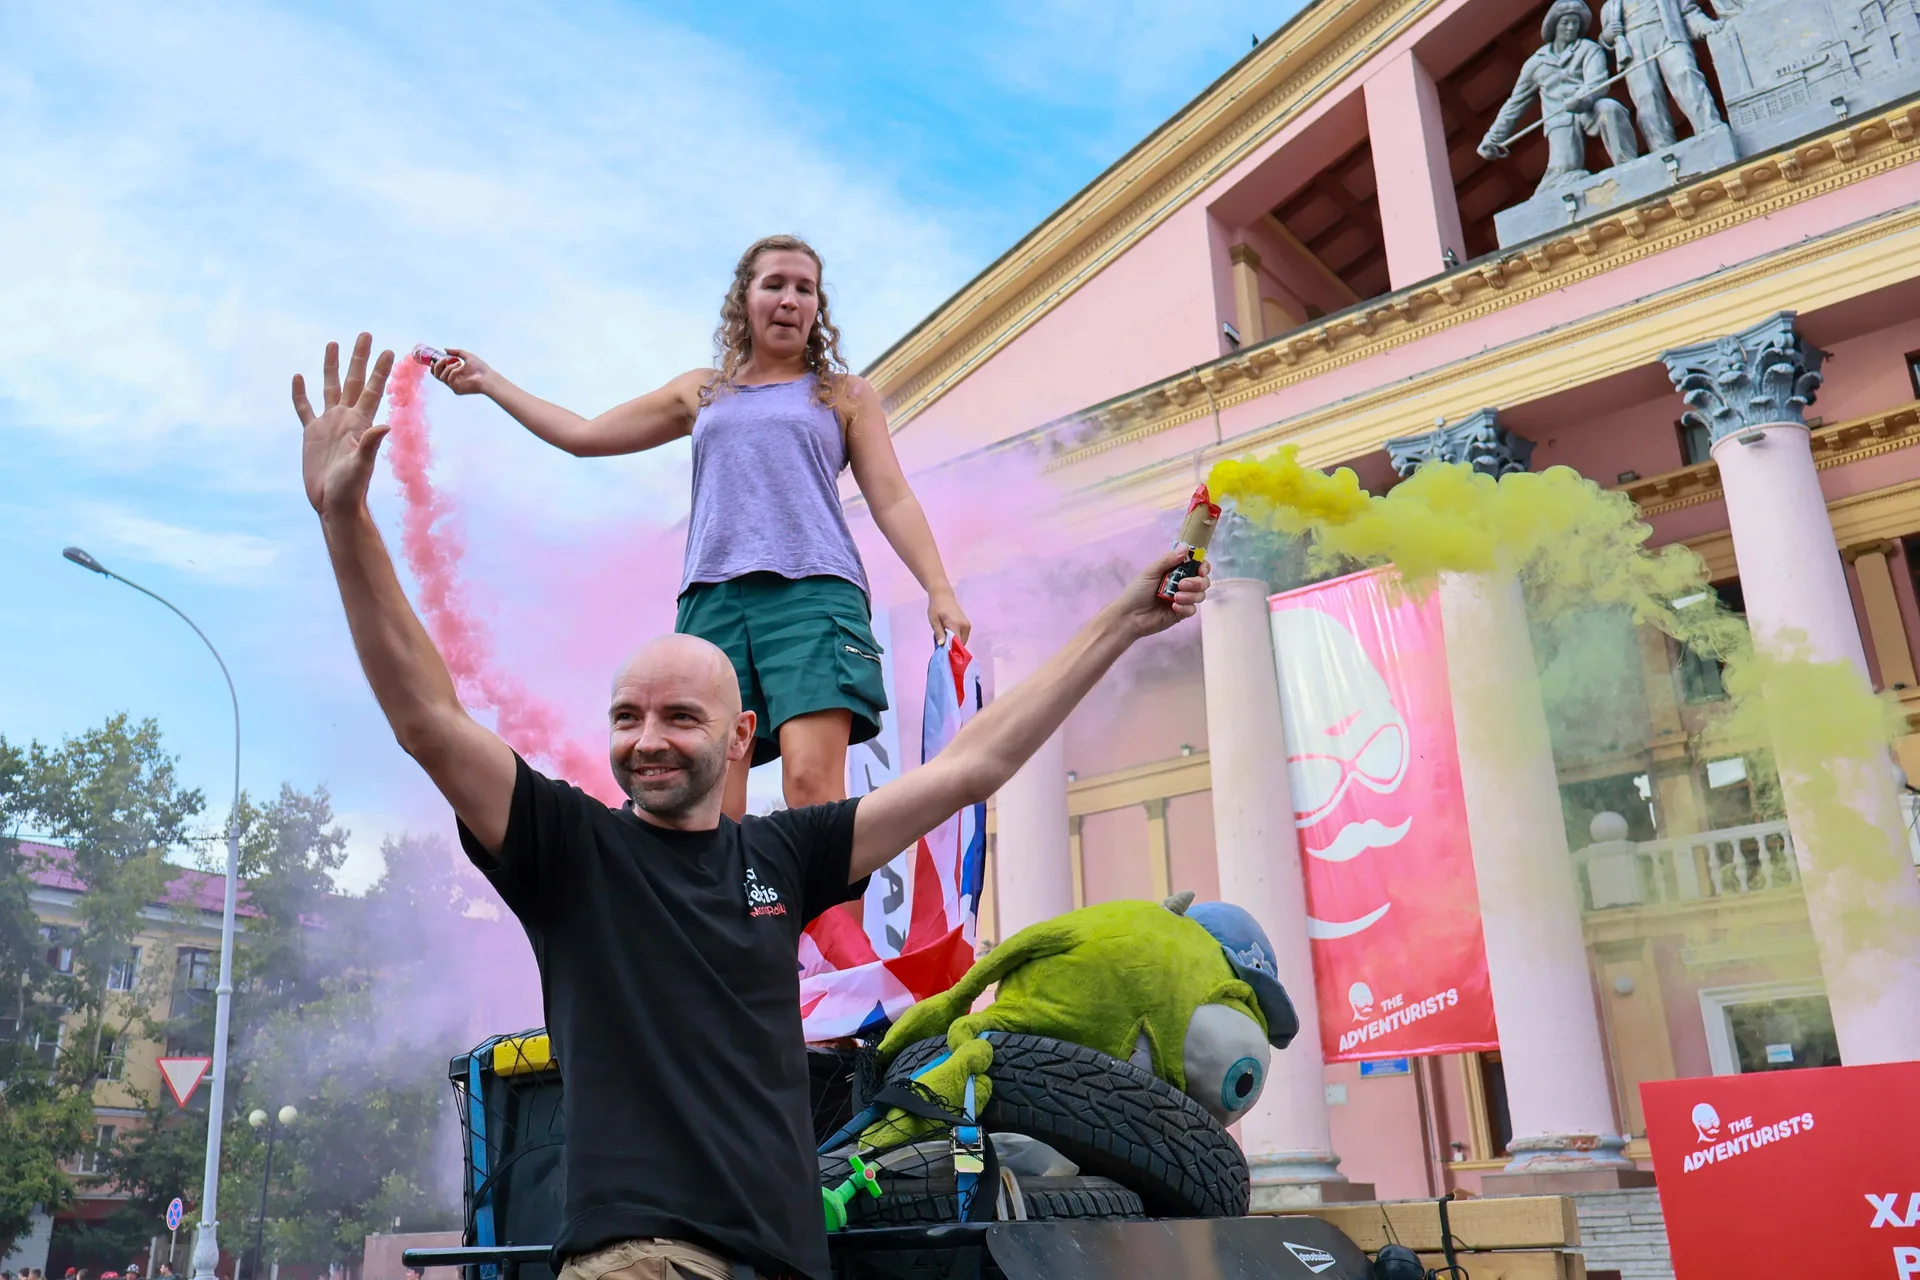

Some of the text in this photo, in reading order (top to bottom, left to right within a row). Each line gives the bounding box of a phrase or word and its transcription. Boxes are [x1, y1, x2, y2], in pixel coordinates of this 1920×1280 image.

[1339, 988, 1459, 1053] ADVENTURISTS
[1380, 993, 1404, 1013] THE
[1683, 1112, 1815, 1174] ADVENTURISTS
[1727, 1115, 1754, 1135] THE
